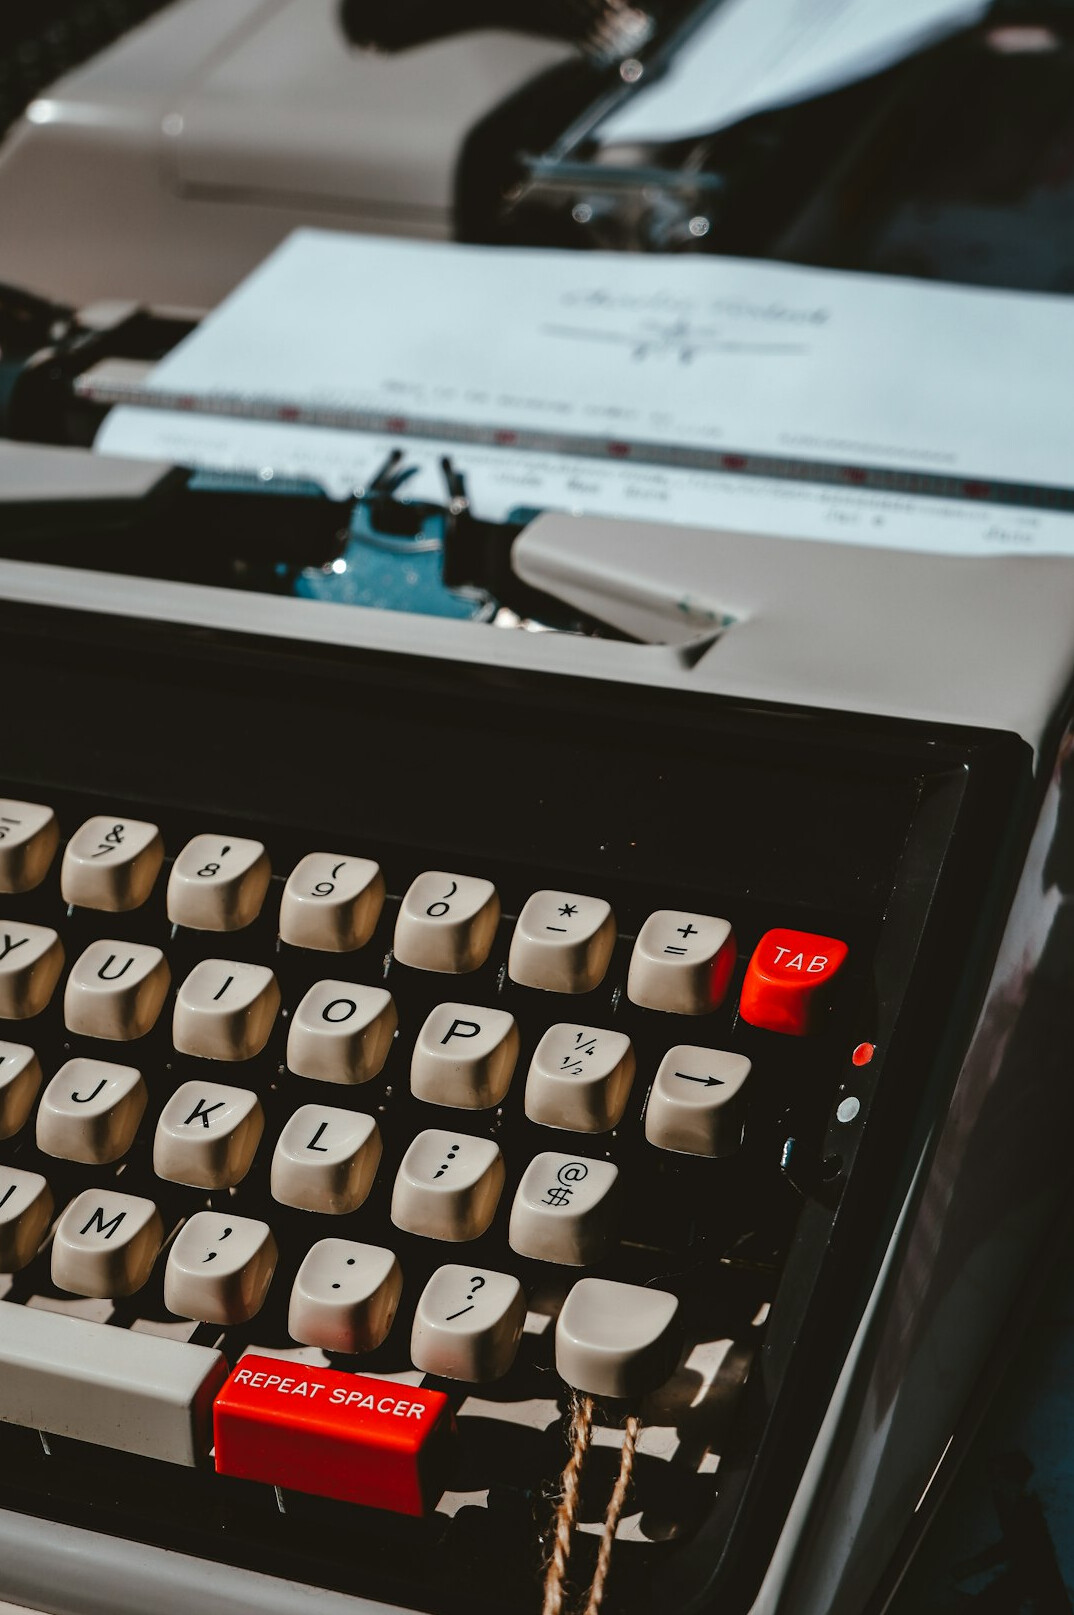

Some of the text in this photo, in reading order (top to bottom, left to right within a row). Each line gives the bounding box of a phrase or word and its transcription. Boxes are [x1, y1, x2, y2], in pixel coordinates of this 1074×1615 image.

[106, 825, 123, 843] &
[93, 845, 115, 856] 7
[197, 864, 220, 876] 8
[332, 863, 345, 879] (
[312, 883, 334, 896] 9
[444, 882, 457, 898] )
[677, 924, 697, 938] +
[0, 935, 28, 960] Y
[664, 946, 687, 955] =
[98, 955, 134, 980] U
[774, 947, 827, 972] TAB
[214, 977, 233, 1000] I
[322, 999, 356, 1022] O
[441, 1020, 480, 1044] P
[72, 1080, 107, 1103] J
[185, 1099, 225, 1128] K
[307, 1122, 328, 1151] L
[447, 1145, 459, 1159] :
[434, 1165, 448, 1178] ;
[557, 1163, 588, 1187] @
[542, 1186, 573, 1206] $
[80, 1207, 126, 1239] M
[468, 1276, 485, 1299] ?
[446, 1306, 474, 1320] /
[234, 1370, 425, 1419] REPEAT SPACER
